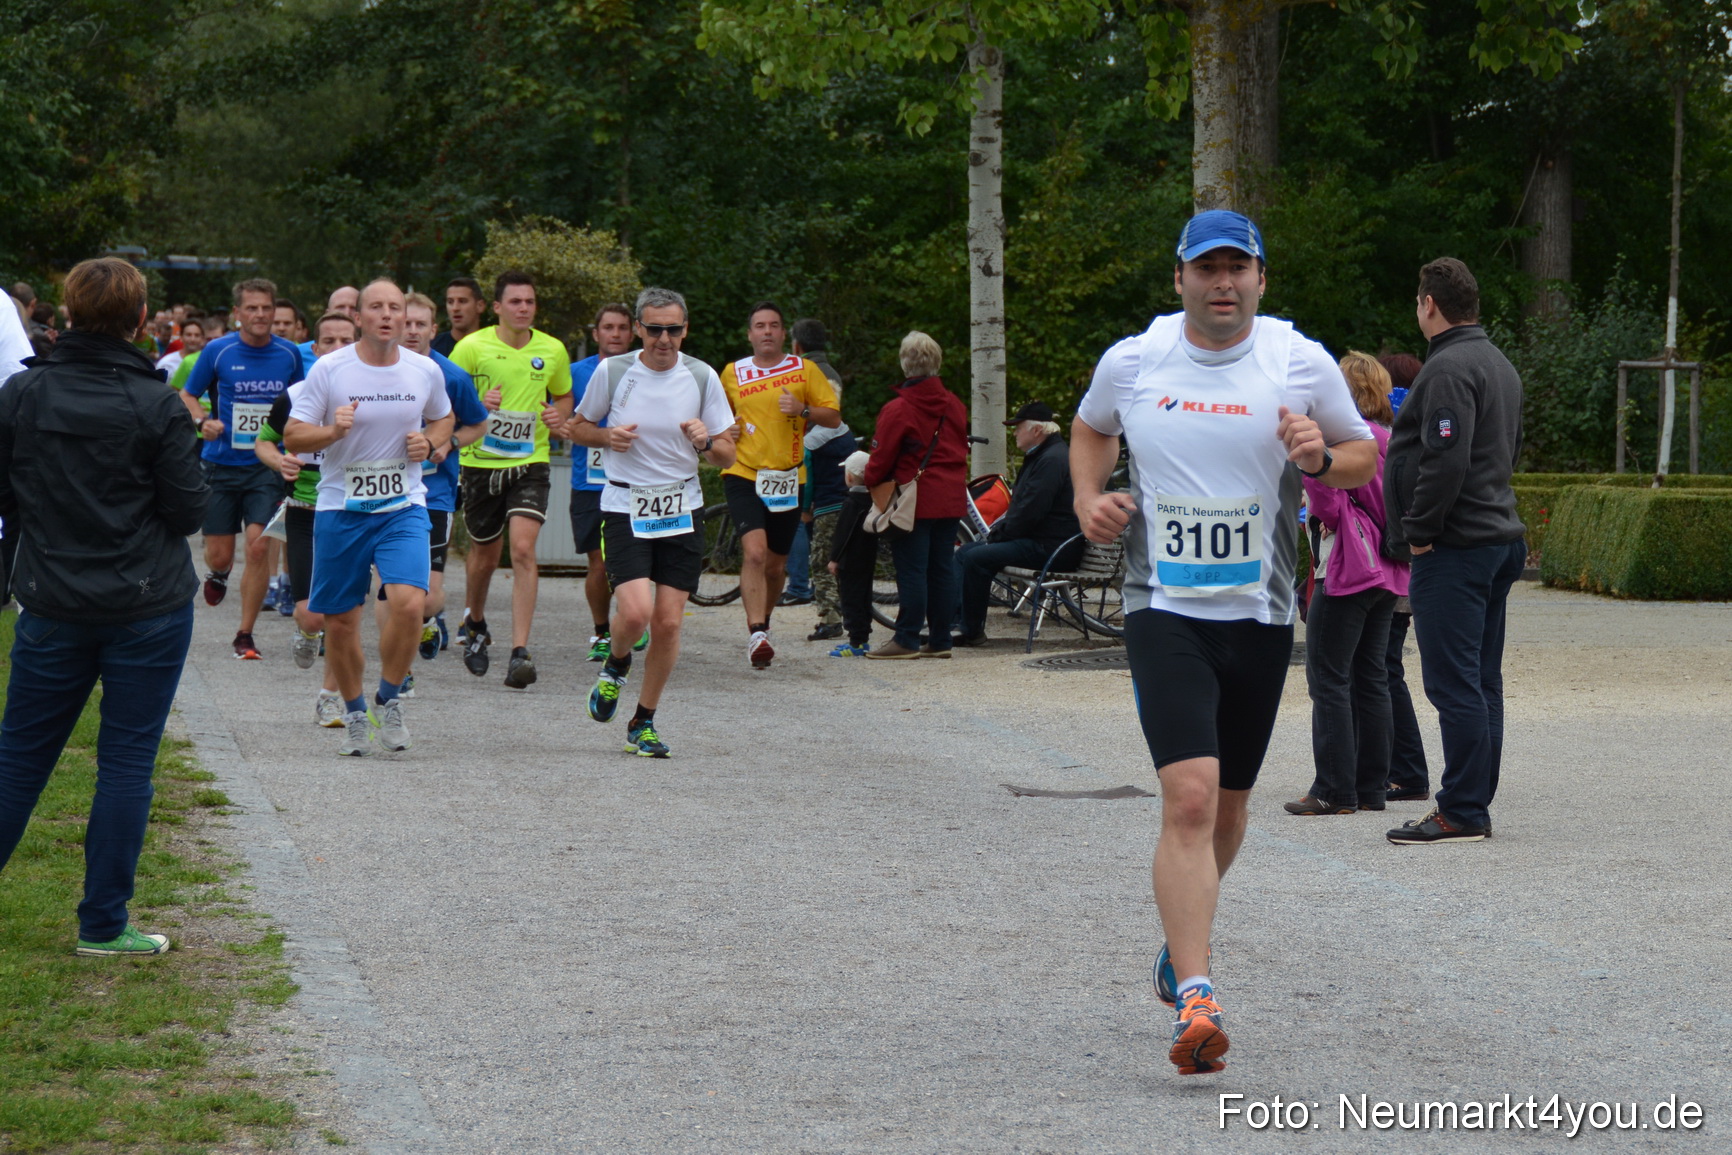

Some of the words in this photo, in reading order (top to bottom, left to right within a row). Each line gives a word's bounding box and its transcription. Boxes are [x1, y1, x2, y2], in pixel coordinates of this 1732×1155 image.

[234, 380, 284, 393] SYSCAD
[739, 383, 768, 399] MAX
[772, 374, 807, 389] BÖGL
[348, 393, 416, 402] www.hasit.de
[1182, 401, 1253, 416] KLEBL
[490, 419, 532, 440] 2204
[367, 464, 397, 472] Neumarkt
[352, 473, 404, 497] 2508
[761, 479, 796, 495] 2787
[637, 493, 683, 517] 2427
[1157, 503, 1190, 516] PARTL
[1192, 507, 1245, 518] Neumarkt
[645, 518, 680, 531] Reinhard
[1165, 520, 1250, 559] 3101
[1183, 565, 1221, 582] Sepp
